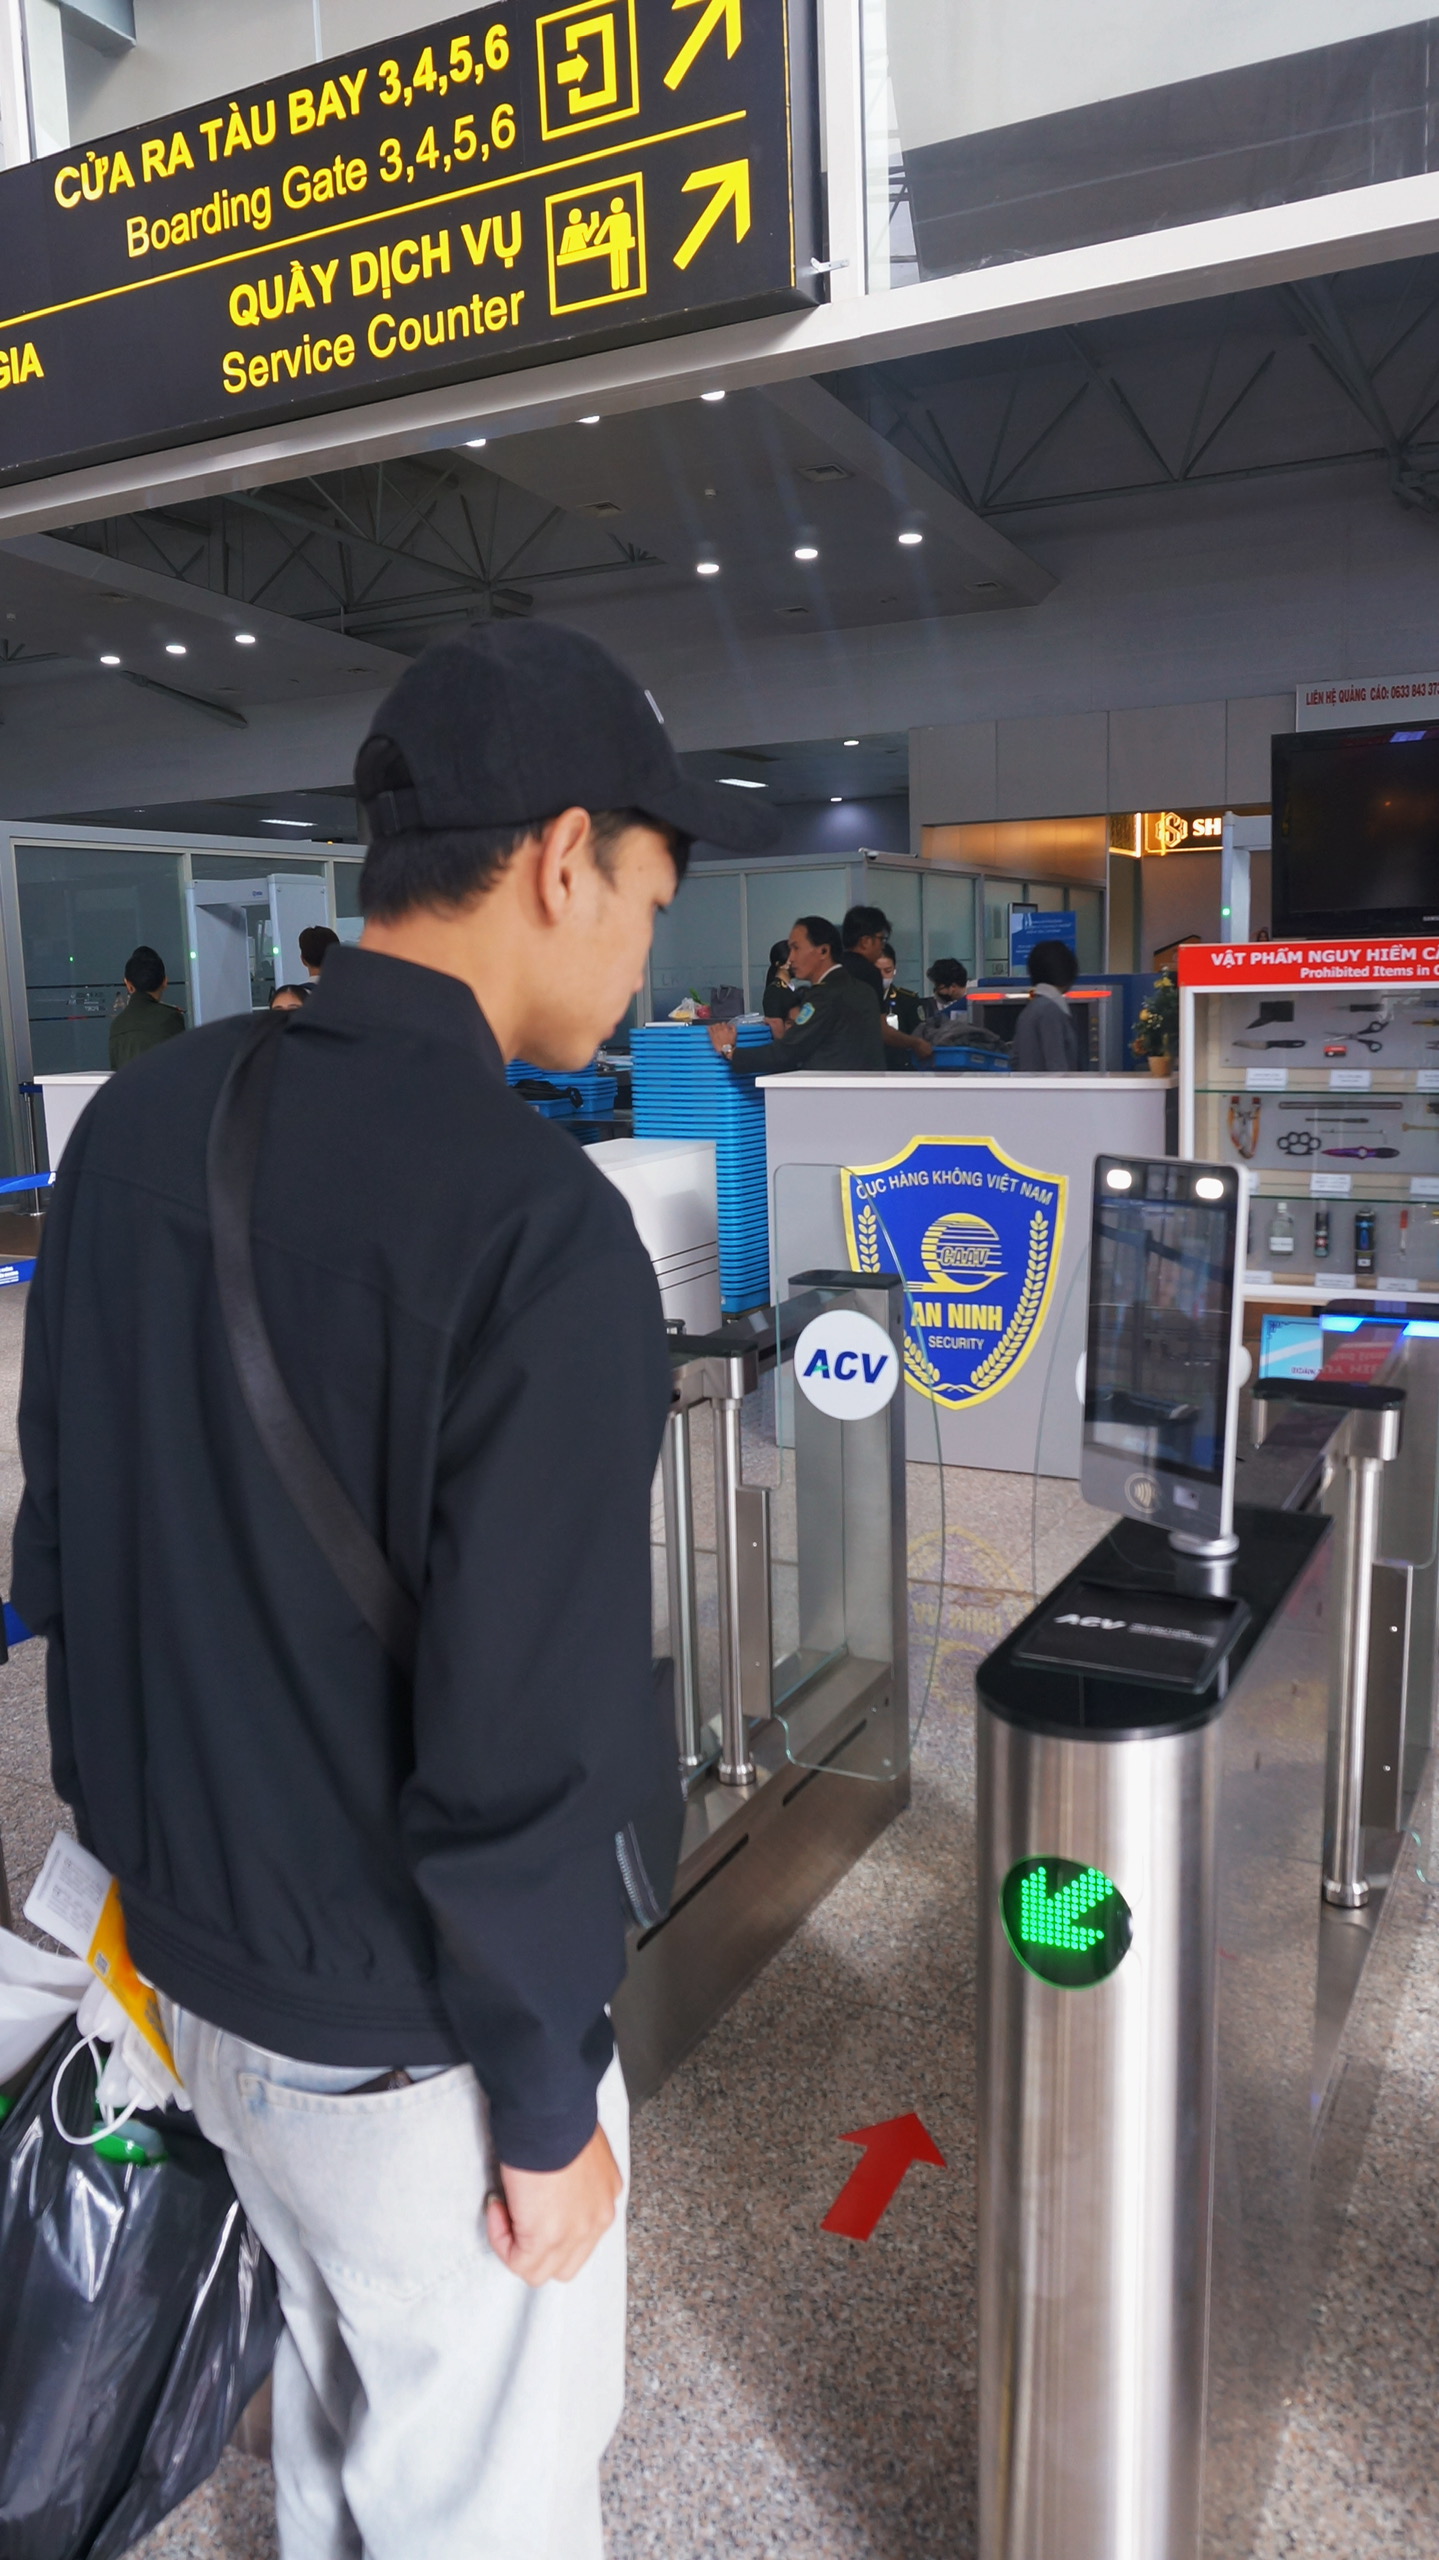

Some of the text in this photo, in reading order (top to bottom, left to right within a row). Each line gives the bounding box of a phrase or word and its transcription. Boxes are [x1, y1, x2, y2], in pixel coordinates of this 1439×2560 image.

[54, 23, 510, 208] CỬA RA TÀU BAY 3,4,5,6
[126, 103, 517, 258] Boarding Gate 3,4,5,6
[228, 210, 523, 327] QUẦY DỊCH VỤ
[222, 290, 525, 394] Service Counter
[0, 342, 45, 389] GIA
[1211, 949, 1246, 968] VẬT
[1308, 949, 1361, 963] NGUY
[1300, 966, 1370, 978] Prohibited
[1373, 965, 1414, 977] Items
[1416, 964, 1430, 976] in
[855, 1166, 1054, 1206] CỤC HÀNG KHÔNG VIỆT NAM
[940, 1246, 990, 1268] CAAV
[910, 1301, 1003, 1332] AN NINH
[928, 1335, 985, 1351] SECURITY
[803, 1349, 888, 1384] ACV
